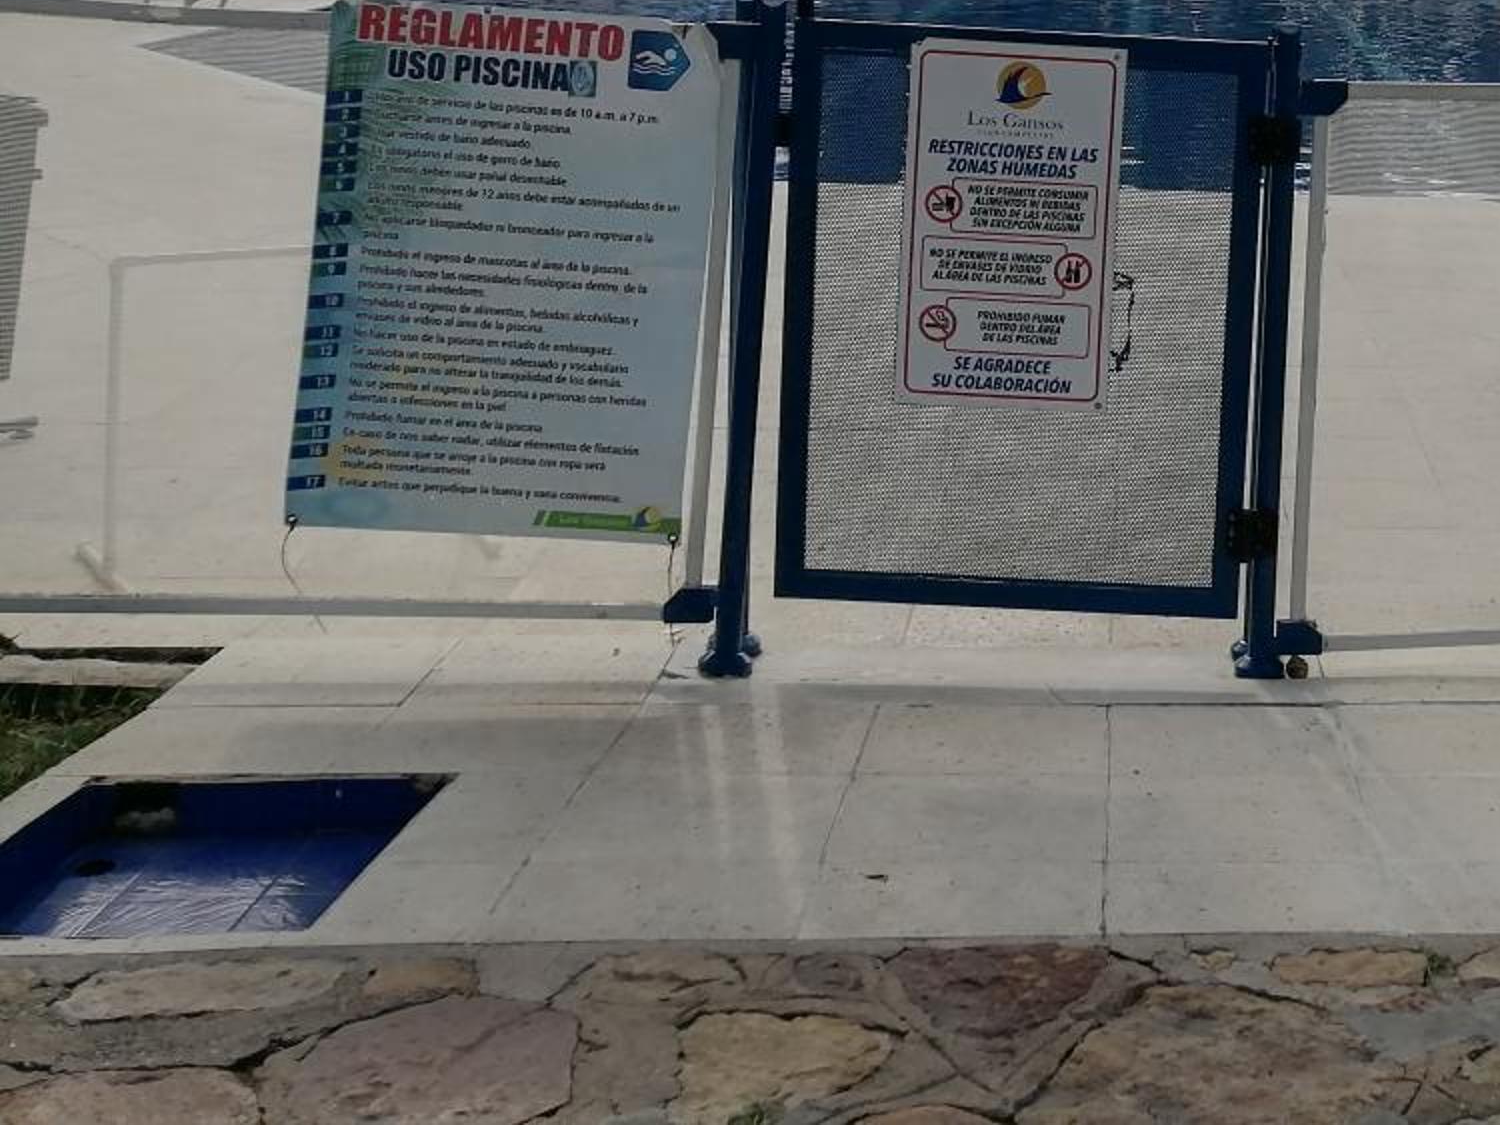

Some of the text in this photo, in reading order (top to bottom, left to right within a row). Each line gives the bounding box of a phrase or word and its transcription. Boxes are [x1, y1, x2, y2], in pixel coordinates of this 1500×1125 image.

[356, 3, 626, 62] REGLAMENTO
[388, 49, 446, 81] USO
[967, 110, 996, 126] Los
[928, 138, 1098, 162] RESTRICCIONES EN LAS
[946, 158, 996, 174] ZONAS
[967, 185, 1088, 200] NO SE PERMITE CONSUMIR
[974, 196, 1026, 207] ALIMENTOS
[1041, 200, 1080, 210] BEBIDAS
[969, 207, 1085, 222] DENTRO DE LAS PISCINAS
[929, 248, 1051, 263] NO SE PERMITE EL INGRESO
[971, 272, 983, 281] DE
[985, 273, 1001, 282] LAS
[1004, 274, 1046, 285] PISCINAS
[977, 311, 1065, 323] PROHIBIDO FUMAR
[979, 322, 1016, 332] DENTRO
[982, 333, 1058, 345] DE LAS PISCINAS
[953, 356, 1052, 374] SE AGRADECE
[931, 373, 1071, 394] SU COLABORACIÓN
